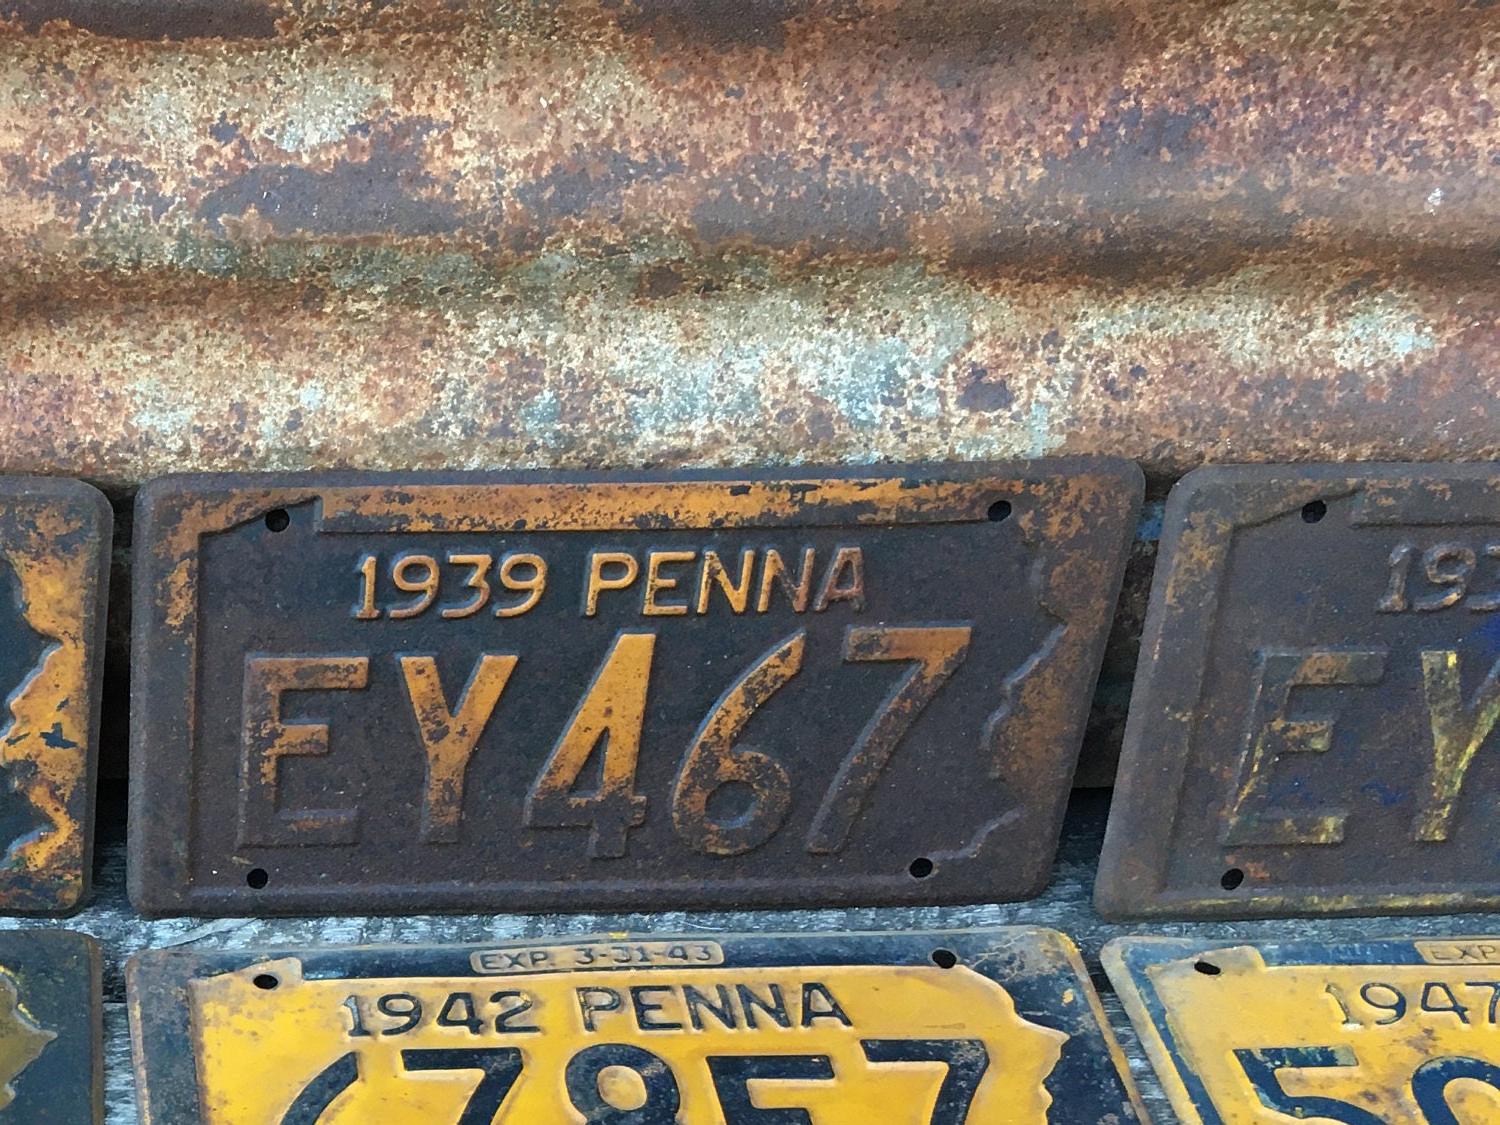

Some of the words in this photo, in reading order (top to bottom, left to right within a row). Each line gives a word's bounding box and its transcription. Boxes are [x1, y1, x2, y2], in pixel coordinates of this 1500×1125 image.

[353, 549, 548, 620] 1939
[582, 545, 865, 617] PENNA
[238, 622, 973, 860] EY467
[573, 943, 713, 966] 3-31-43
[343, 990, 540, 1038] 1942
[577, 981, 853, 1033] PENNA
